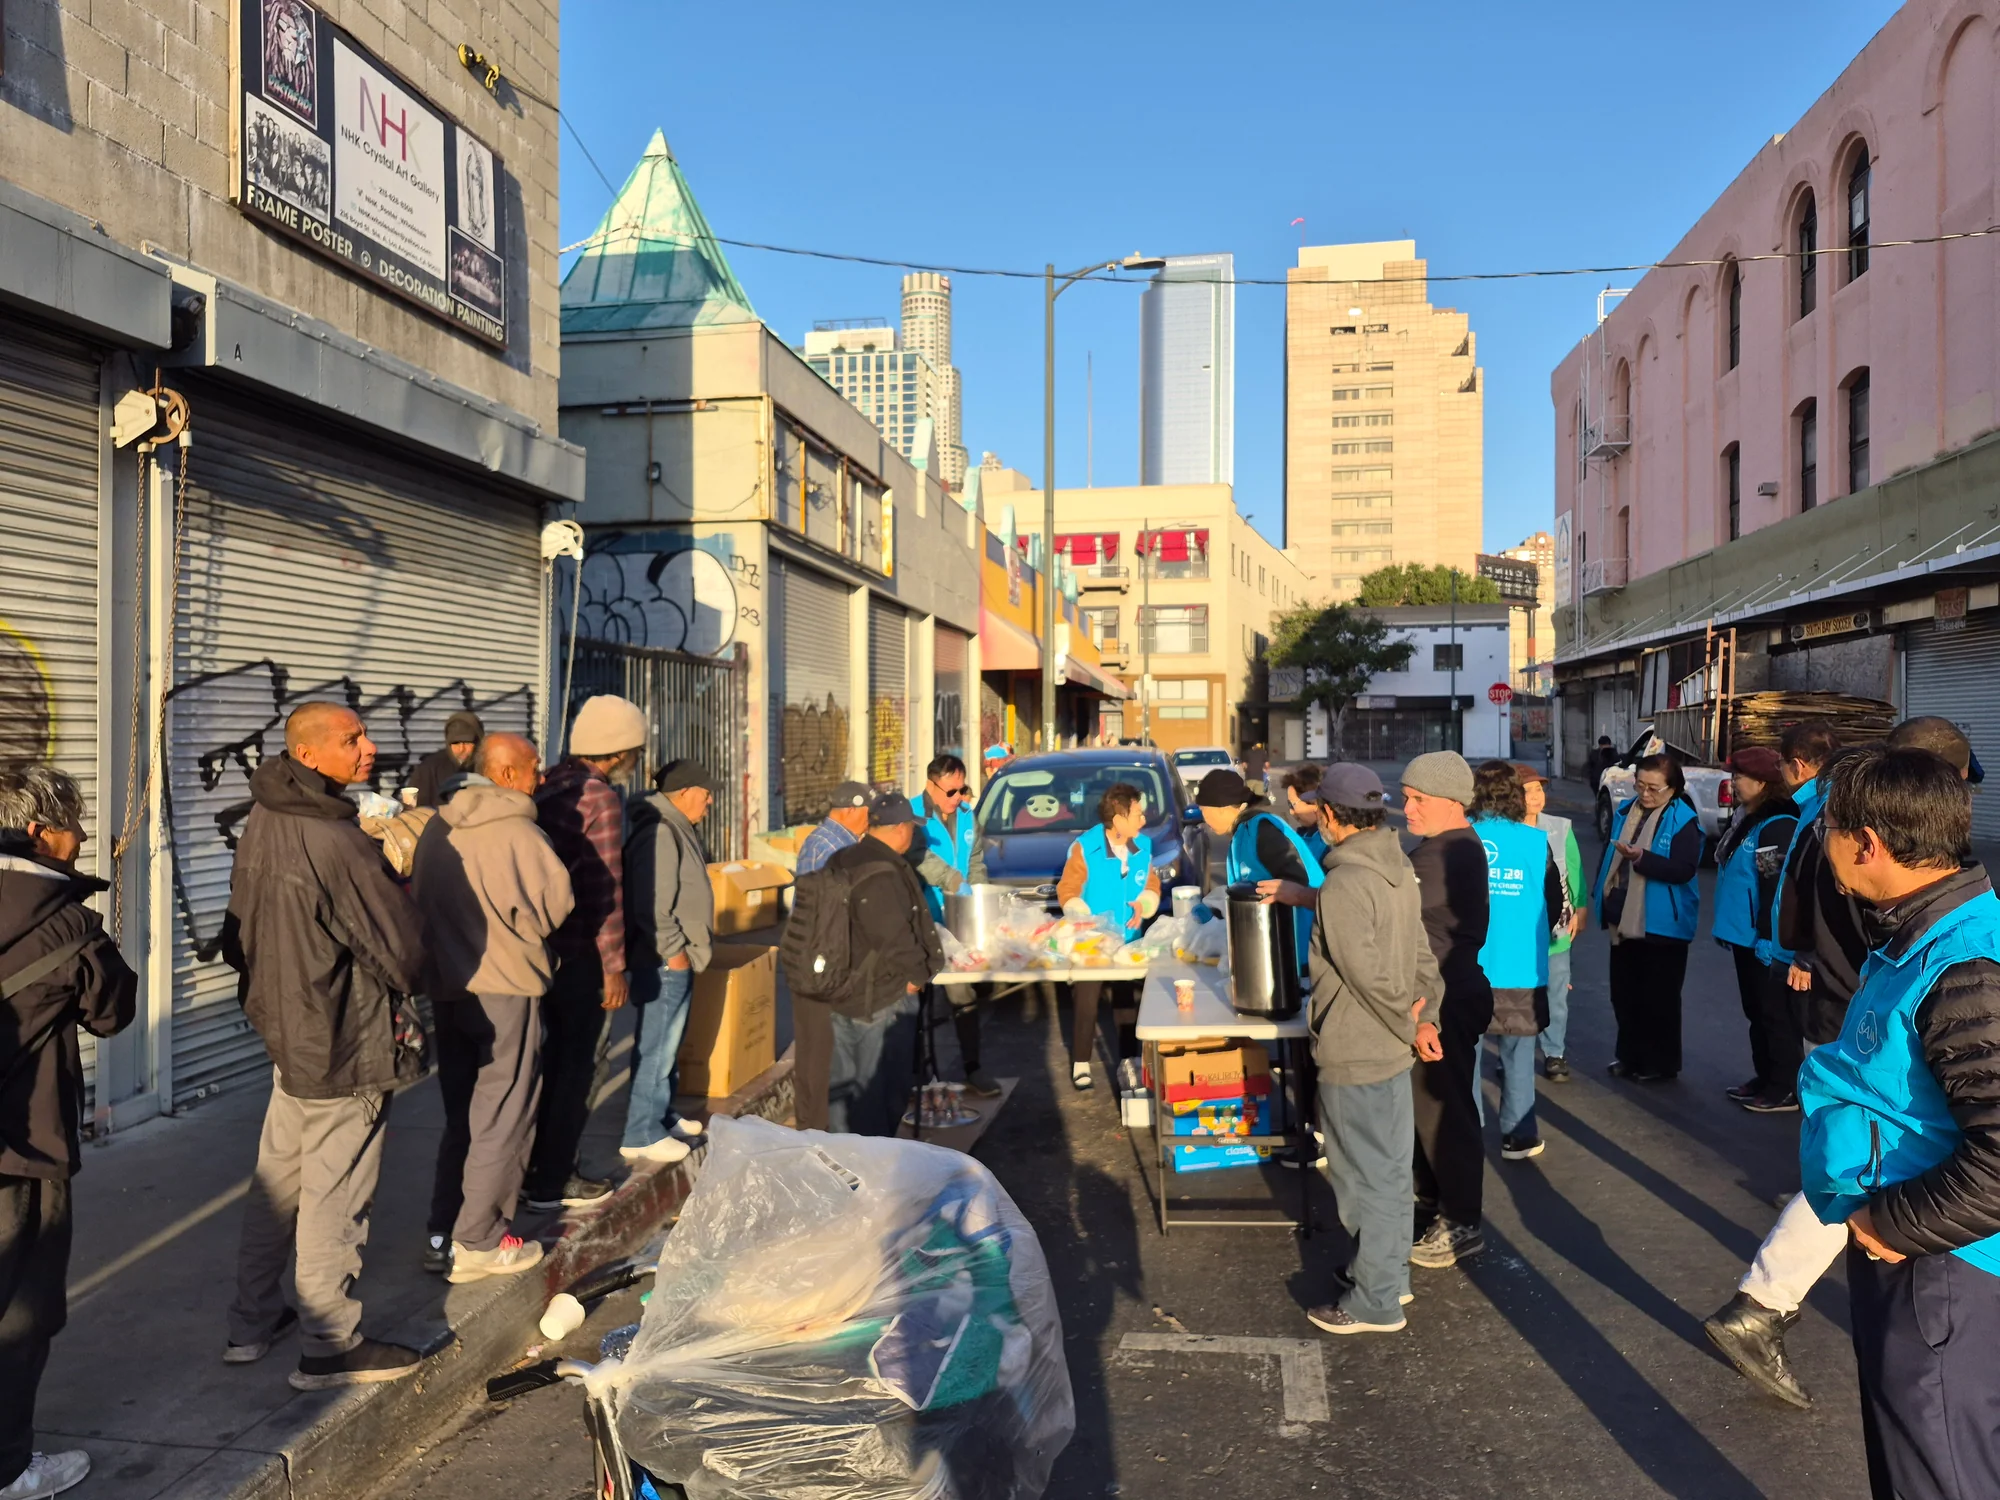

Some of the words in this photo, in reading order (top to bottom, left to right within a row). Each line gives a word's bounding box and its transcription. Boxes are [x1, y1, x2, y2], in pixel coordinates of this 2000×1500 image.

[360, 76, 422, 174] NHK
[341, 124, 361, 149] NHK
[363, 141, 394, 171] Crystal
[396, 164, 408, 181] Art
[410, 174, 440, 204] Gallery
[247, 185, 298, 229] FRAME
[302, 216, 353, 259] POSTER
[379, 259, 454, 315] DECORATION
[457, 303, 504, 341] PAINTING
[234, 343, 243, 362] A
[1805, 624, 1821, 637] SOUTH
[1821, 621, 1832, 634] BAY
[1832, 616, 1853, 632] SOCCER
[1489, 688, 1511, 700] STOP
[1503, 868, 1524, 880] 교회
